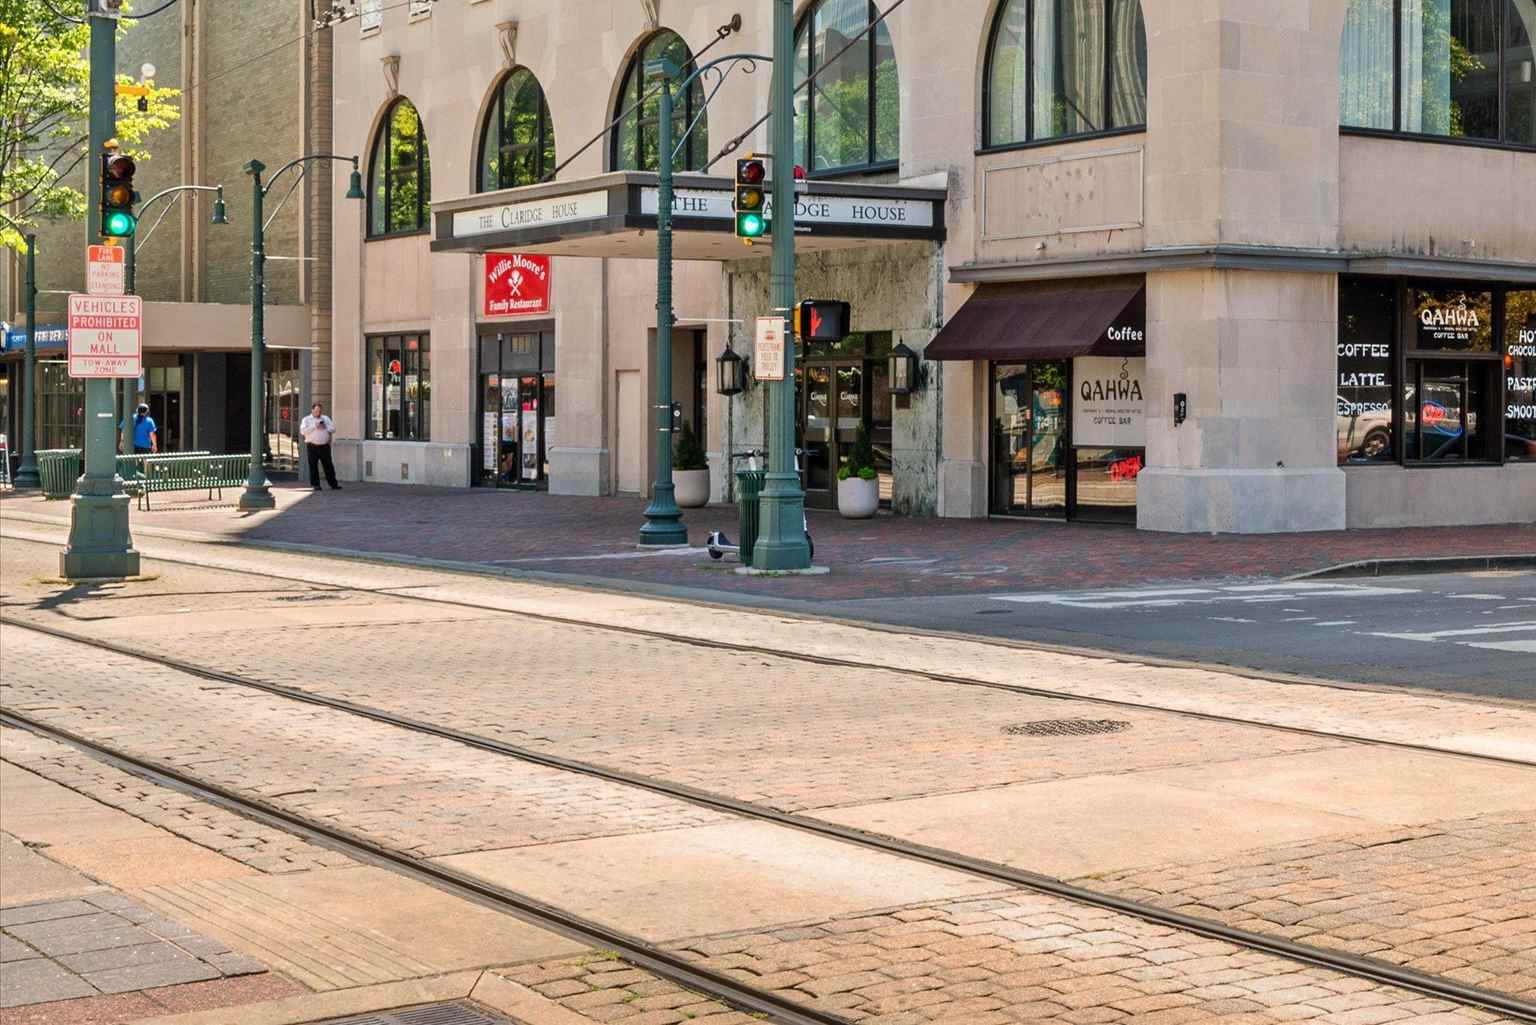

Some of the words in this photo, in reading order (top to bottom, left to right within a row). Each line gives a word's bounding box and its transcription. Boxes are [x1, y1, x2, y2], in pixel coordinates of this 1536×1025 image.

[479, 215, 493, 229] THE
[552, 202, 578, 219] HOUSE
[672, 197, 708, 213] THE
[852, 205, 906, 221] HOUSE
[489, 259, 513, 284] Willie
[512, 254, 546, 280] Moore's
[74, 301, 136, 314] VEHICLES
[489, 298, 509, 312] Family
[509, 298, 542, 310] Restaurant
[72, 316, 137, 328] PROHIBITED
[1421, 309, 1480, 327] QAHWA
[98, 331, 113, 342] ON
[1107, 326, 1143, 340] Coffee
[90, 344, 120, 354] MALL
[1337, 343, 1389, 357] COFFEE
[1340, 373, 1385, 386] LATTE
[1081, 379, 1143, 402] QAHWA
[1337, 402, 1388, 416] ESPRESSO
[1093, 416, 1116, 425] COFFEE
[1119, 416, 1131, 425] BAR
